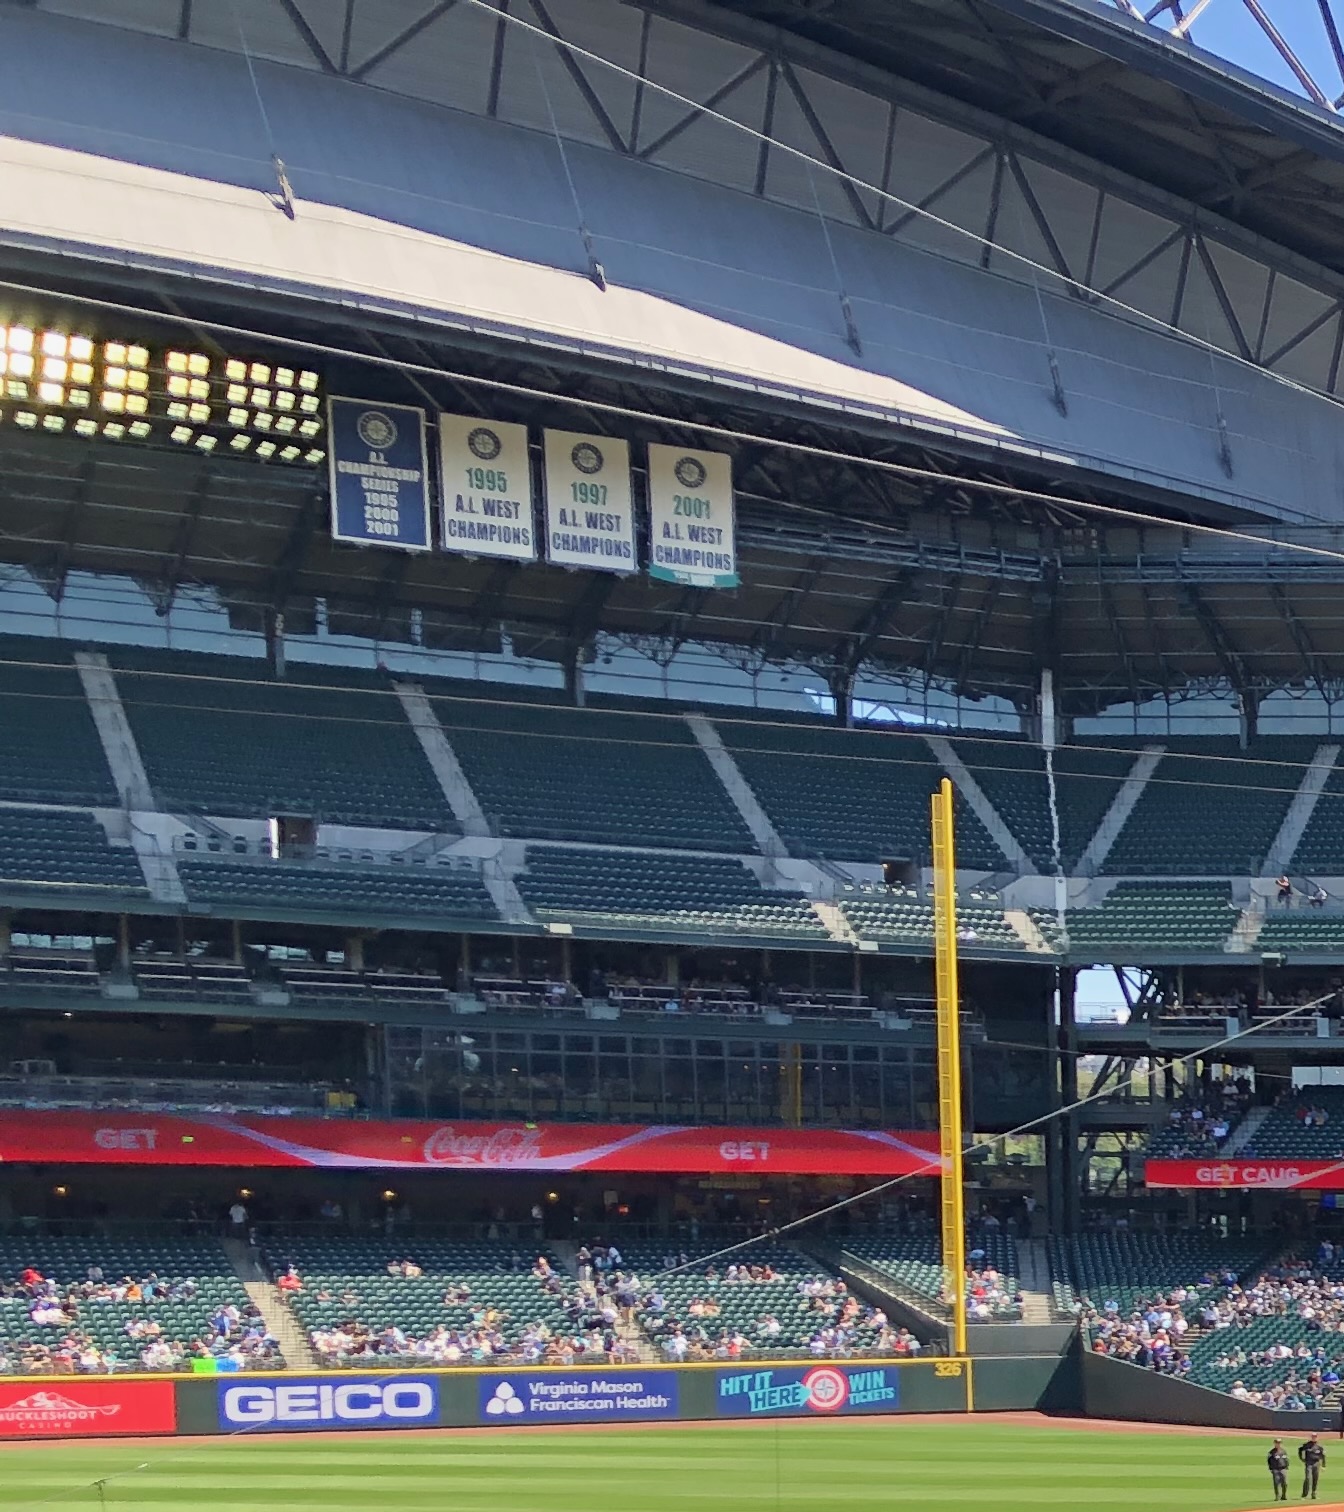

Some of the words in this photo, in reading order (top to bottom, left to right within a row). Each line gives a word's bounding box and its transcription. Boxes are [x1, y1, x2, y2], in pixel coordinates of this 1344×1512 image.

[337, 460, 421, 482] CHAMPIONSHIP
[465, 467, 508, 494] 1995
[361, 477, 399, 493] SERIES
[571, 481, 607, 506] 1997
[364, 491, 398, 507] 1995
[455, 494, 480, 514] A.L.
[482, 497, 520, 520] WEST
[672, 494, 710, 520] 2001
[364, 505, 399, 521] 2000
[559, 508, 582, 527] A.L.
[585, 511, 621, 532] WEST
[366, 520, 399, 537] 2001
[448, 519, 530, 546] CHAMPIONS
[662, 521, 685, 540] A.L.
[687, 524, 722, 545] WEST
[552, 531, 631, 558] CHAMPIONS
[655, 544, 731, 570] CHAMPIONS
[95, 1128, 156, 1149] GET
[720, 1142, 770, 1160] GET
[1196, 1167, 1238, 1183] GET
[1242, 1167, 1299, 1182] CAUG
[934, 1362, 962, 1376] 326
[529, 1382, 588, 1398] Virginia
[592, 1381, 643, 1394] Mason
[720, 1376, 751, 1396] HIT
[755, 1371, 773, 1390] IT
[849, 1370, 885, 1392] WIN
[225, 1382, 433, 1422] GEICO
[530, 1398, 613, 1412] Franciscan
[617, 1394, 668, 1409] Health
[755, 1387, 800, 1408] HERE
[850, 1388, 895, 1404] TICKETS
[18, 1421, 72, 1429] CASINO
